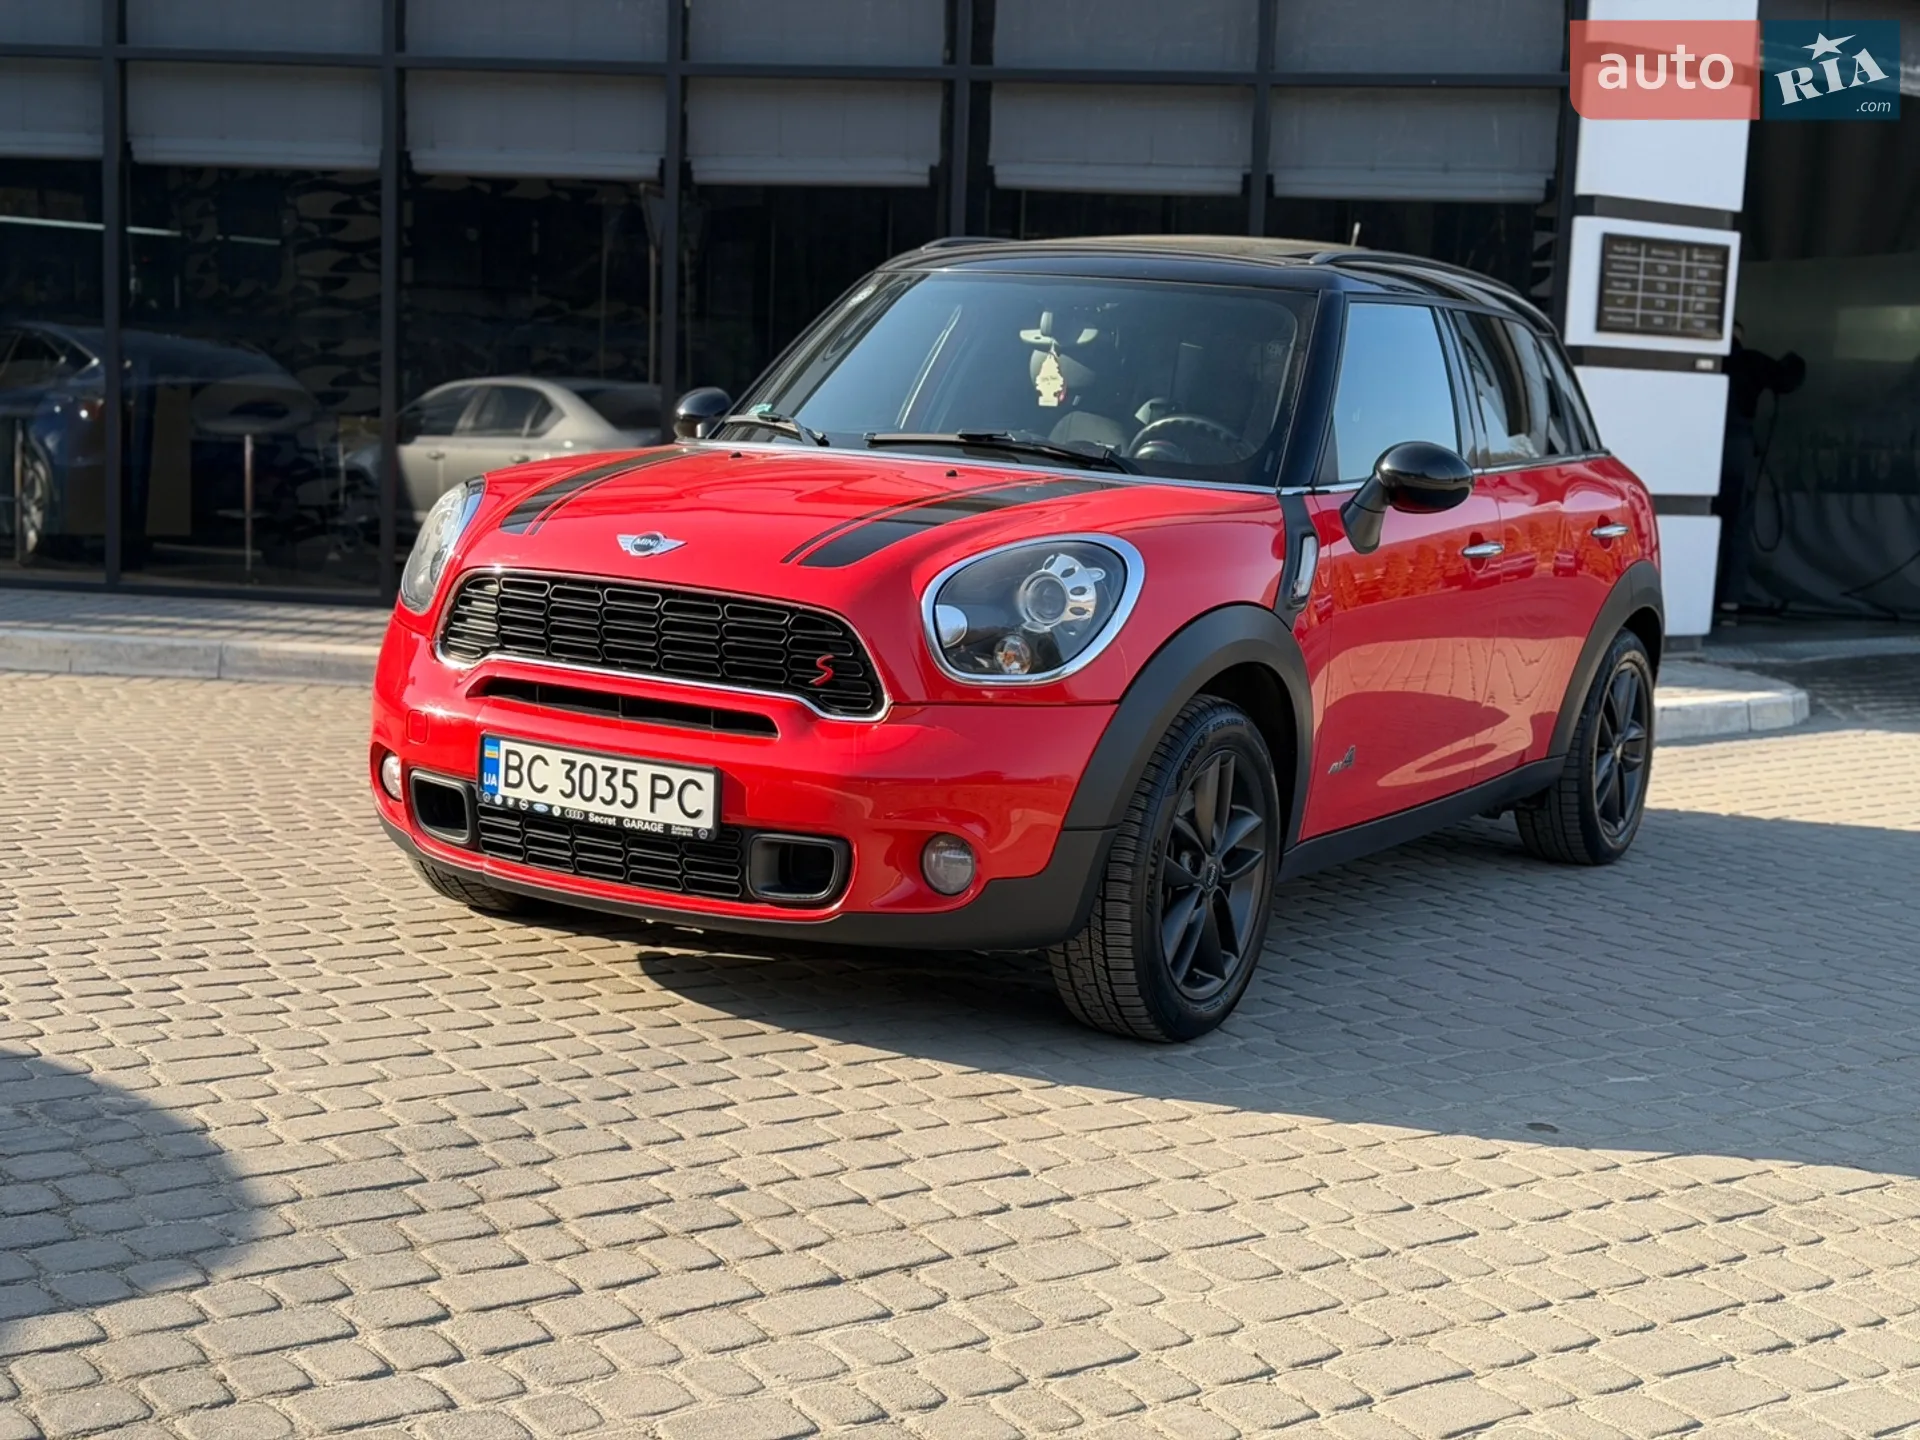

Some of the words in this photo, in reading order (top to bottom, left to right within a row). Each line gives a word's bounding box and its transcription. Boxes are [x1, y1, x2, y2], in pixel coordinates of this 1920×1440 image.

[636, 537, 659, 547] MINI
[808, 654, 835, 687] S
[483, 772, 497, 787] UA
[504, 749, 549, 794] BC
[558, 758, 638, 809] 3035
[650, 773, 704, 819] PC
[588, 812, 617, 827] Secret
[623, 818, 664, 834] GARAGE
